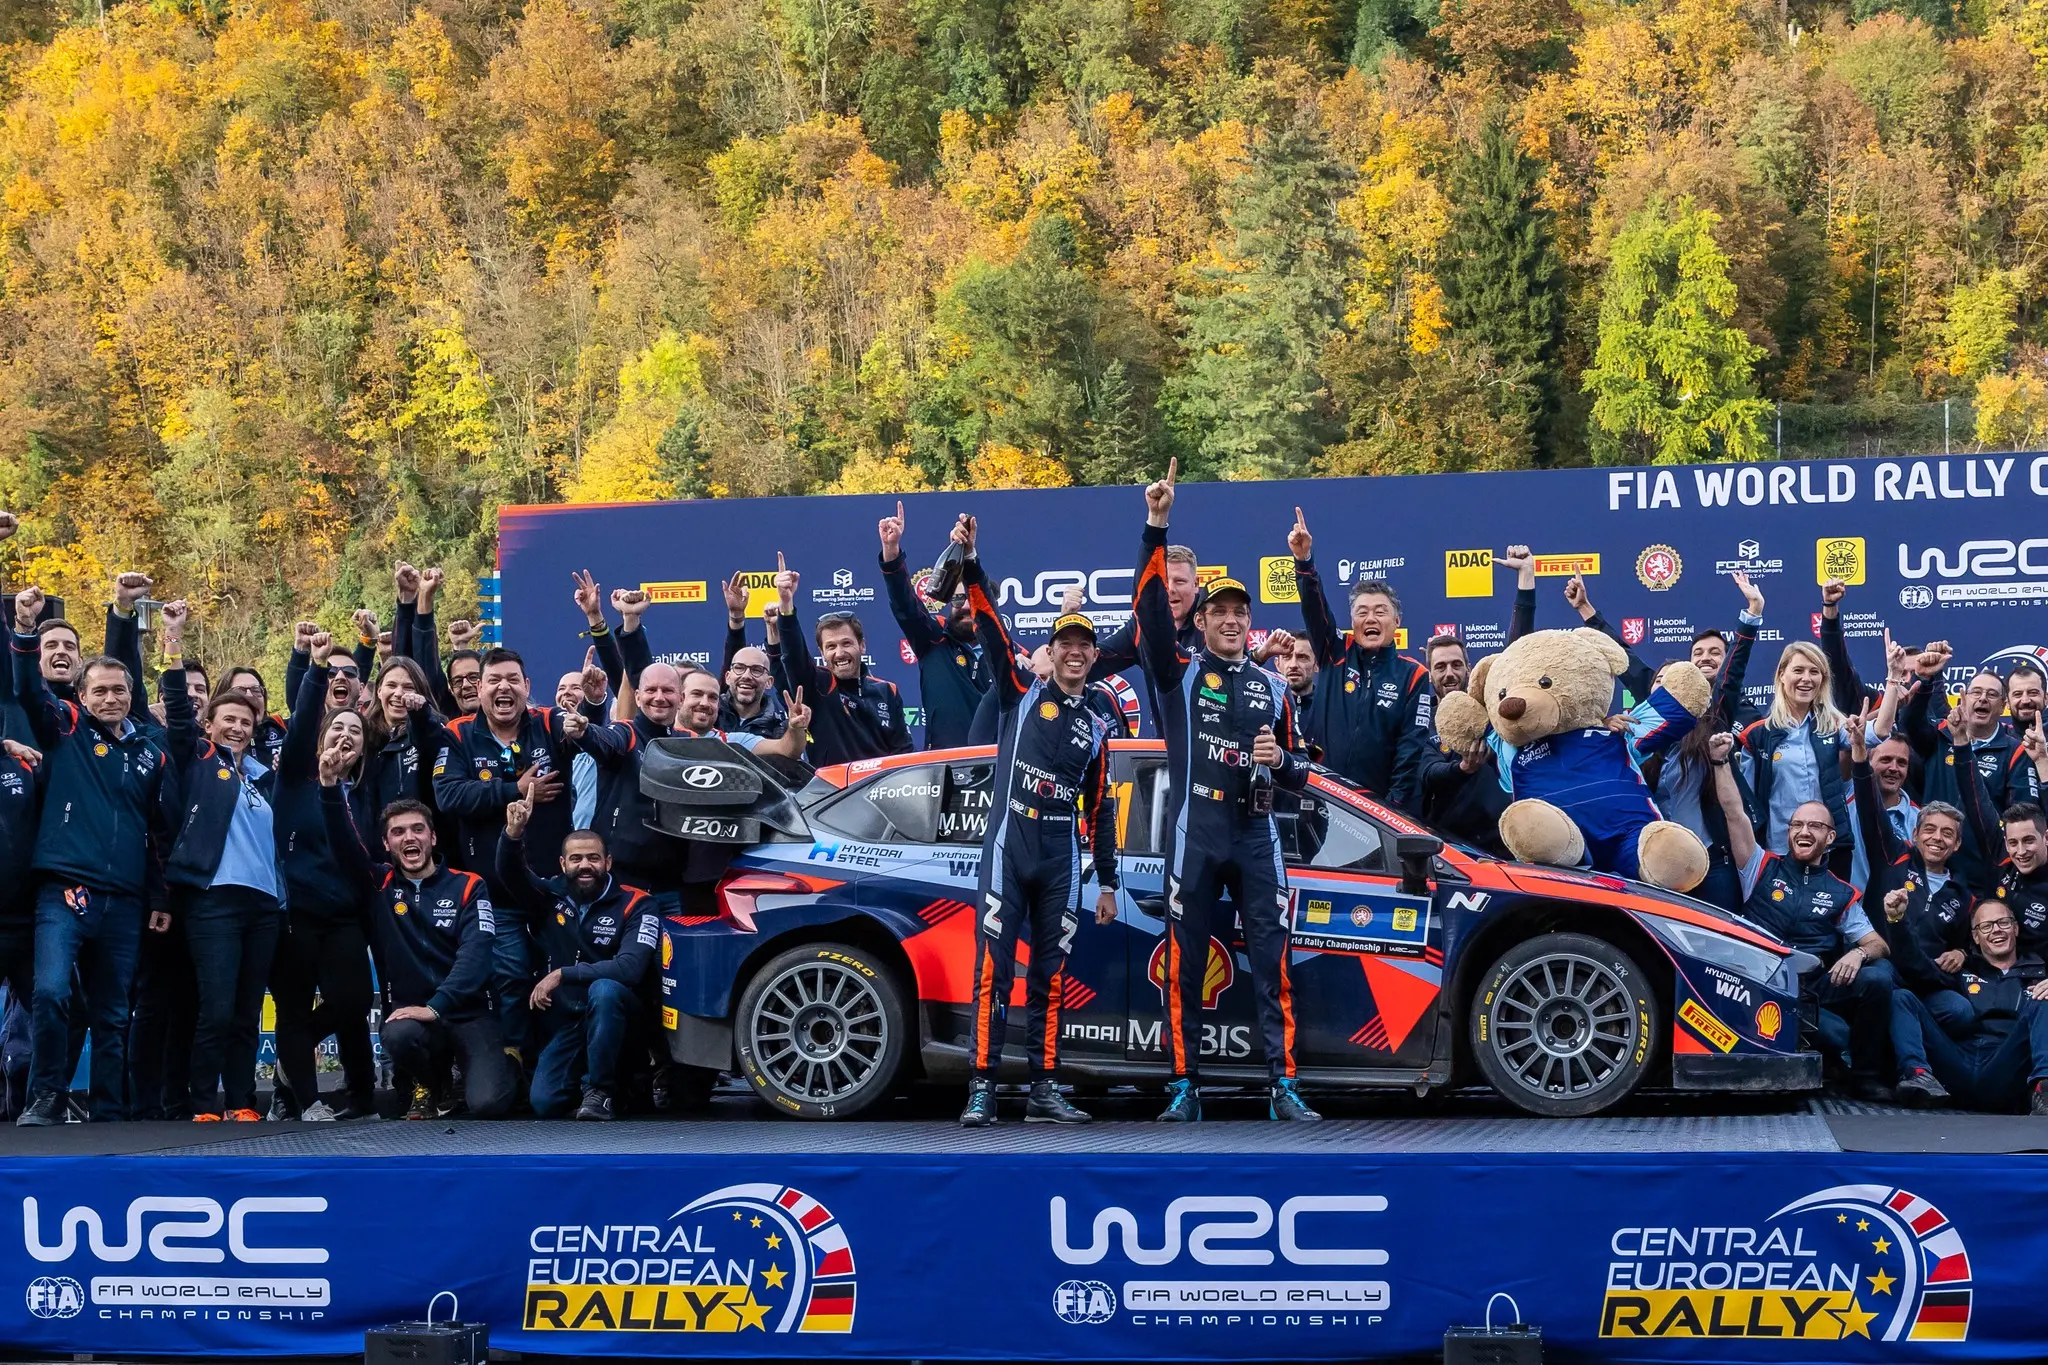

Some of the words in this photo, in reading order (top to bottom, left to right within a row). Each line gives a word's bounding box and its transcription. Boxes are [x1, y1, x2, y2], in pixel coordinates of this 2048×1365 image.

[1608, 470, 1681, 510] FIA
[1693, 464, 1857, 508] WORLD
[1874, 458, 2016, 501] RALLY
[1360, 560, 1383, 571] CLEAN
[1383, 557, 1405, 568] FUELS
[1448, 551, 1491, 568] ADAC
[1535, 557, 1594, 572] PIRELLI
[1716, 559, 1783, 569] FORUM8
[1360, 571, 1375, 580] FOR
[1375, 570, 1387, 579] ALL
[646, 585, 701, 600] PIRELLI
[813, 588, 874, 598] FORUM8
[997, 568, 1136, 606] WRC
[1941, 588, 1962, 596] FIA
[1966, 587, 2018, 595] WORLD
[2022, 586, 2048, 594] RAL
[1902, 592, 1931, 605] FIA
[1018, 616, 1038, 624] FIA
[1092, 614, 1132, 622] RALL
[1653, 616, 1687, 626] NÁRODNÍ
[1843, 612, 1876, 621] NÁRODNÍ
[1465, 622, 1498, 632] NÁRODNÍ
[1653, 625, 1694, 635] SPORTOVNÍ
[1843, 620, 1885, 629] SPORTOVNÍ
[1465, 631, 1506, 640] SPORTOVNÍ
[1654, 634, 1693, 643] AGENTURA
[1466, 640, 1504, 648] AGENTURA
[652, 652, 710, 664] ahiKASEI
[1243, 690, 1271, 701] HYUNDAI
[1744, 685, 1762, 696] LEAN
[1199, 731, 1239, 749] HYUNDAI
[1208, 744, 1253, 768] MOBI
[852, 760, 883, 772] OMP
[1015, 759, 1056, 782] HYUNDAI
[869, 783, 941, 801] #ForCraig
[1022, 773, 1076, 802] MOBIS
[960, 789, 993, 807] T.N
[939, 813, 988, 836] M.Wy
[1333, 816, 1371, 844] HYUNDAI
[841, 844, 903, 859] HYUNDAI
[932, 851, 980, 860] HYUNDAI
[837, 854, 881, 868] STEEL
[1133, 862, 1165, 874] INN
[949, 861, 980, 877] WI
[1308, 901, 1331, 911] ADAC
[1291, 936, 1303, 945] rld
[1304, 937, 1324, 949] Rally
[1326, 939, 1381, 953] Championship
[1704, 966, 1741, 984] HYUNDAI
[1716, 979, 1751, 1007] WIA
[1683, 1004, 1732, 1047] PIRELLI
[1062, 1024, 1121, 1042] UNDAI
[1127, 1018, 1251, 1058] MBIS
[23, 1195, 330, 1264] WRC
[1050, 1195, 1390, 1266] WRC
[529, 1225, 717, 1254] CENTRAL
[1610, 1226, 1818, 1257] CENTRAL
[527, 1258, 755, 1286] EUROPEAN
[1607, 1262, 1860, 1291] EUROPEAN
[29, 1284, 82, 1310] FIA
[98, 1284, 134, 1298] FIA
[141, 1285, 230, 1298] WORLD
[238, 1285, 324, 1299] RALLY
[1131, 1289, 1171, 1302] FIA
[1179, 1289, 1278, 1302] WORLD
[1287, 1289, 1382, 1302] RALLY
[1057, 1289, 1113, 1316] FIA
[99, 1308, 325, 1321] CHAMPIONSHIP
[525, 1290, 730, 1331] RALLY
[1601, 1295, 1832, 1337] RALLY
[1132, 1315, 1383, 1326] CHAMPIONSHIP
